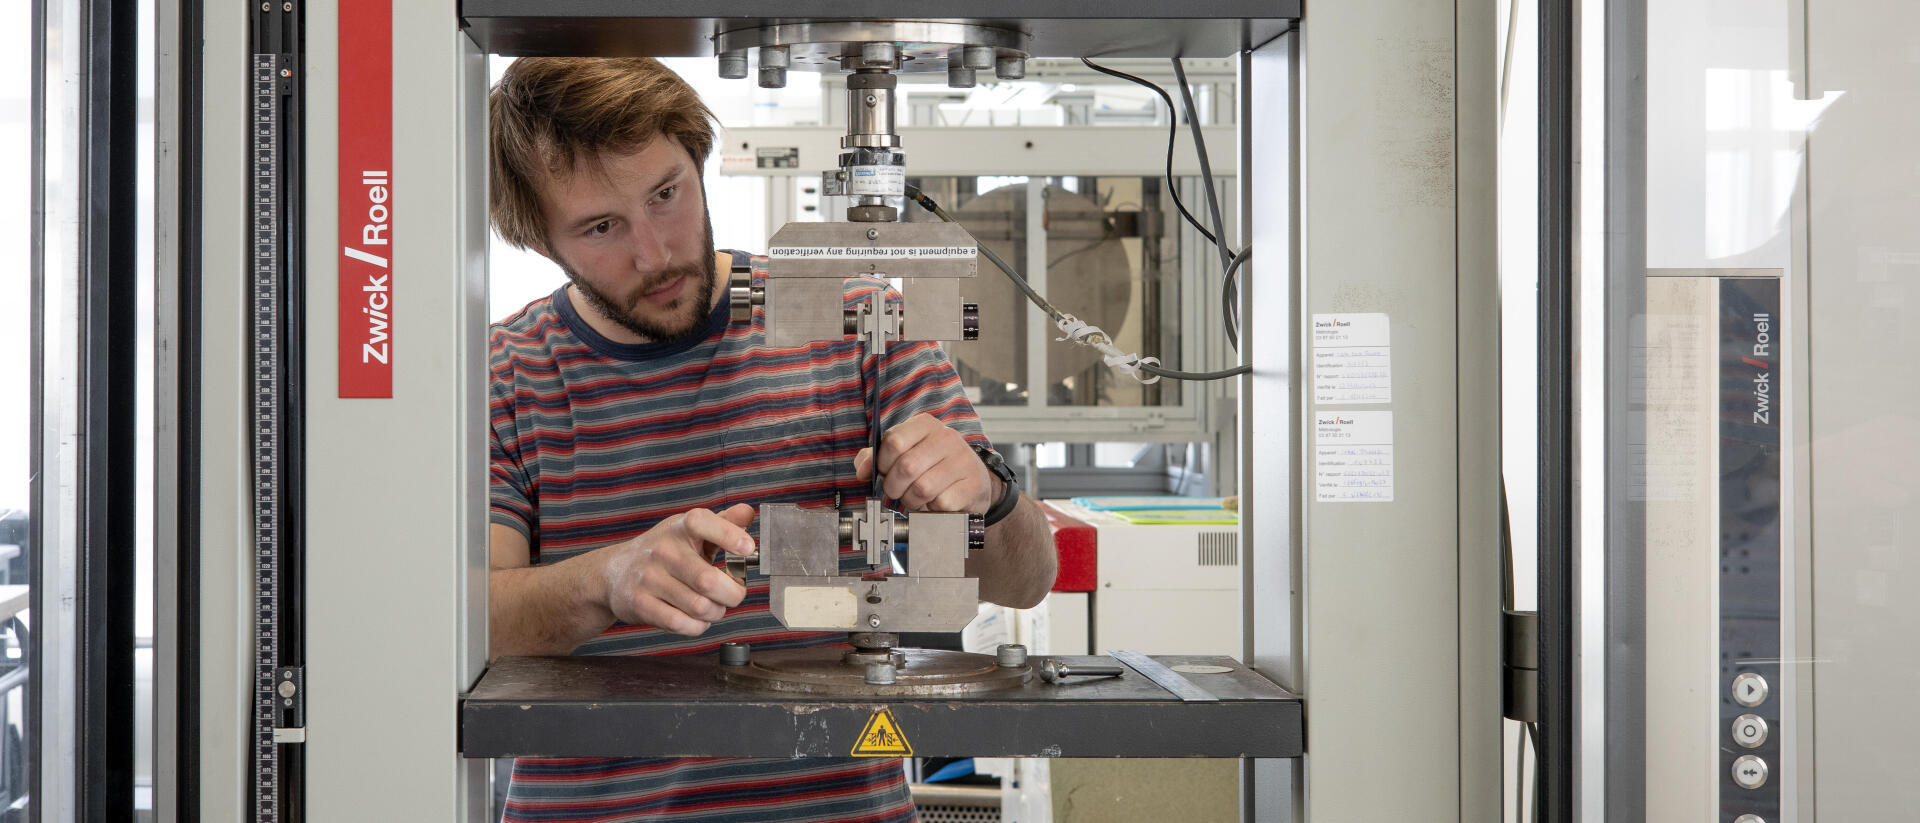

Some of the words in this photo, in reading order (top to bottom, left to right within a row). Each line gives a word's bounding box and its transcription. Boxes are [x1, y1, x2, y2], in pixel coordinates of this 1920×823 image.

[362, 170, 388, 245] Roell
[846, 248, 888, 256] requiring
[920, 248, 968, 256] equipment
[362, 274, 388, 364] Zwick
[1754, 313, 1769, 356] Roell
[1754, 372, 1769, 424] Zwick
